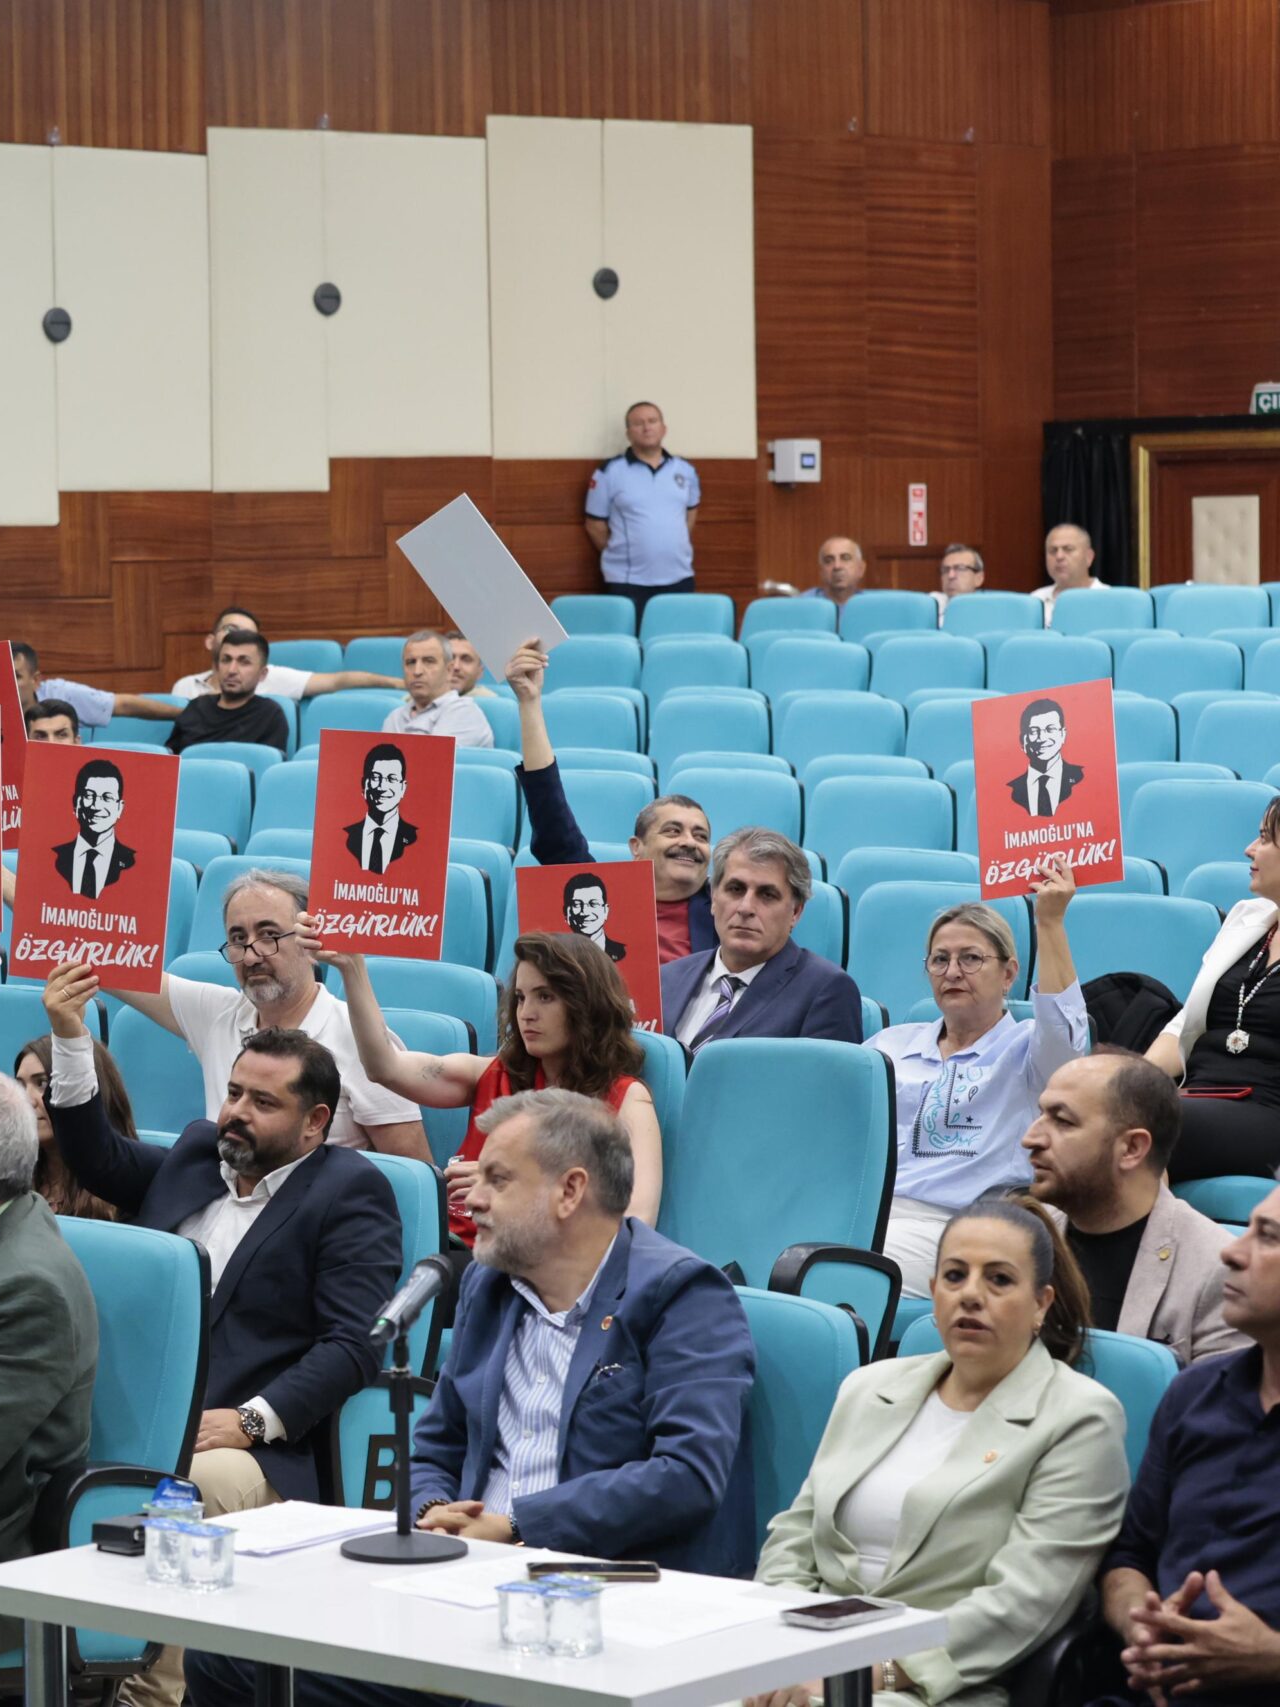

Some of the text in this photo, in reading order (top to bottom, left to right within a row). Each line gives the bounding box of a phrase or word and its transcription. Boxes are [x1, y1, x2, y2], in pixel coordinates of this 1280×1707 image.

[1259, 394, 1280, 413] ÇI
[1004, 821, 1094, 849] İMAMOĞLU'NA
[333, 880, 419, 906] İMAMOĞLU'NA
[41, 903, 137, 934] İMAMOĞLU'NA
[15, 932, 159, 968] ÖZGÜRLÜK!
